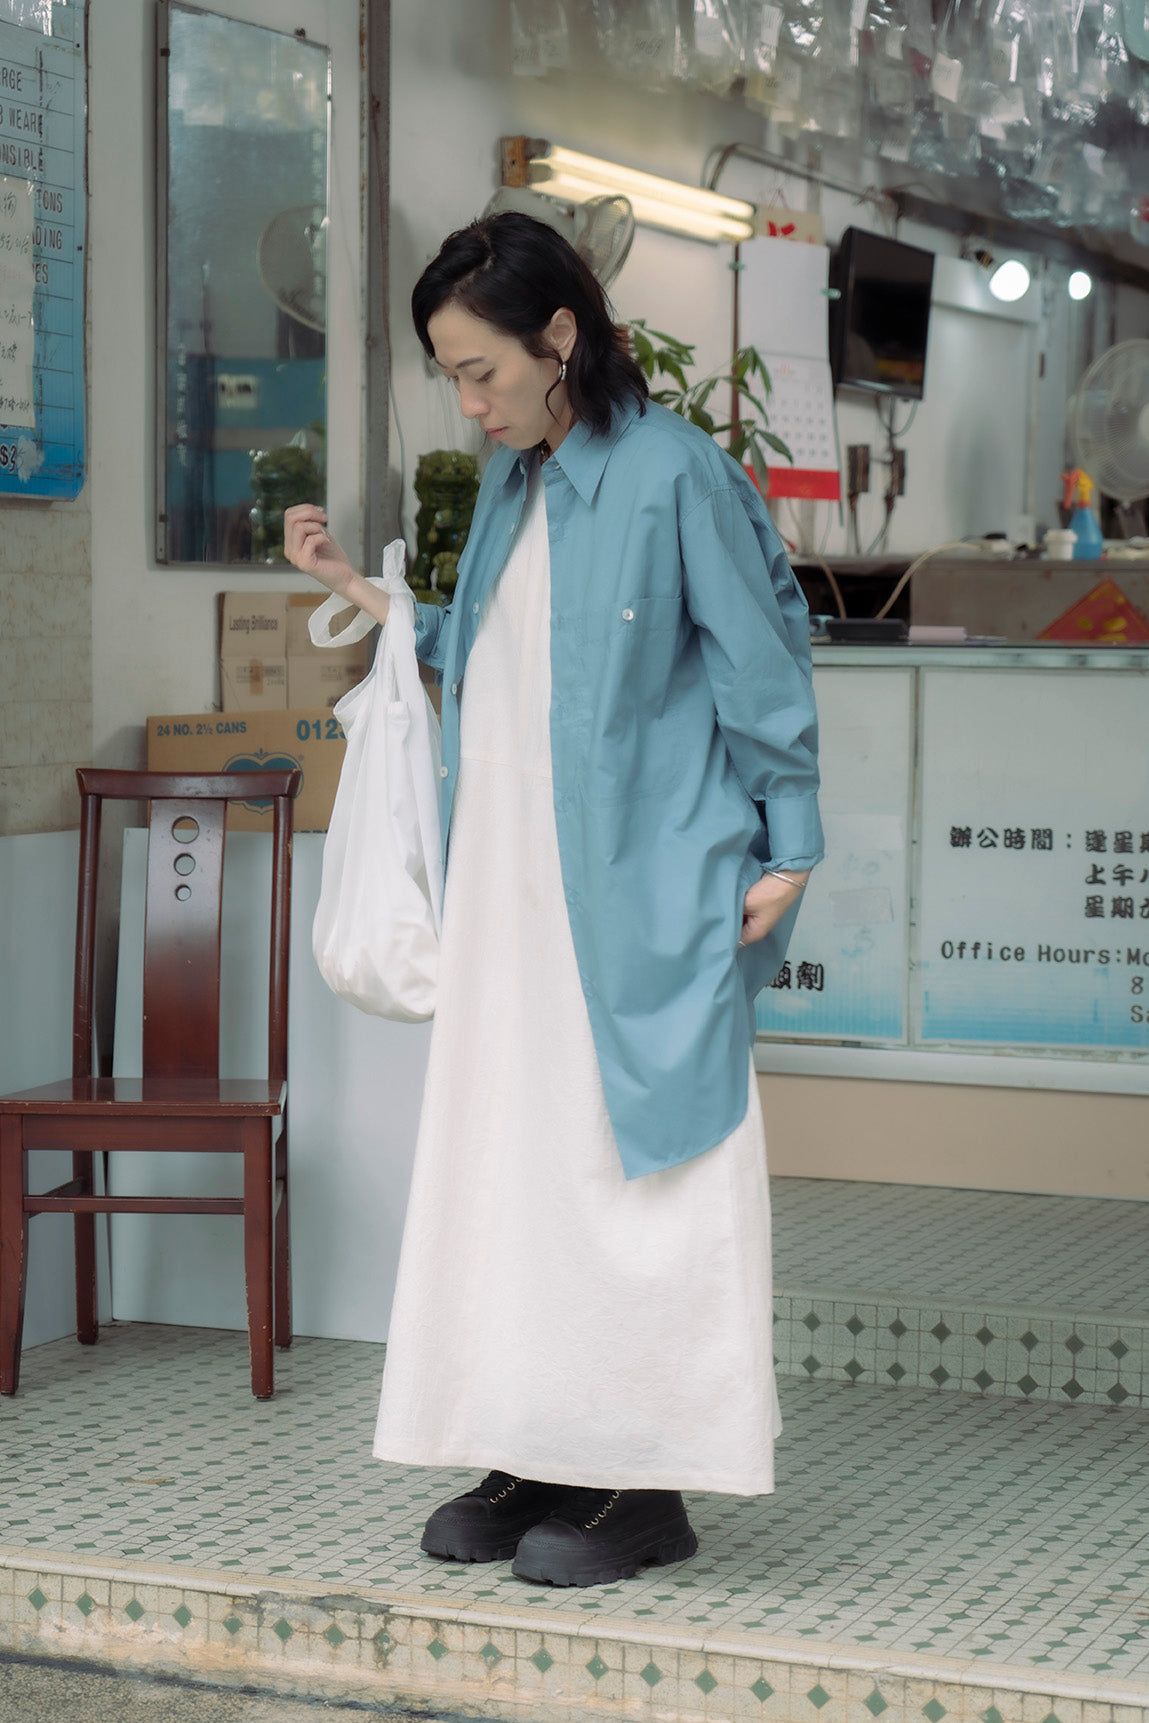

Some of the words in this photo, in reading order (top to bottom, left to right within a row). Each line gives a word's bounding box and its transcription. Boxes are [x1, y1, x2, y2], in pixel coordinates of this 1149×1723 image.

[0, 143, 43, 171] NSIBLE
[32, 262, 49, 284] ES
[157, 724, 170, 737] 24
[173, 723, 193, 736] NO.
[216, 721, 247, 734] CANS
[941, 940, 1025, 961] Office
[1131, 976, 1144, 995] 8
[1131, 1005, 1149, 1023] S
